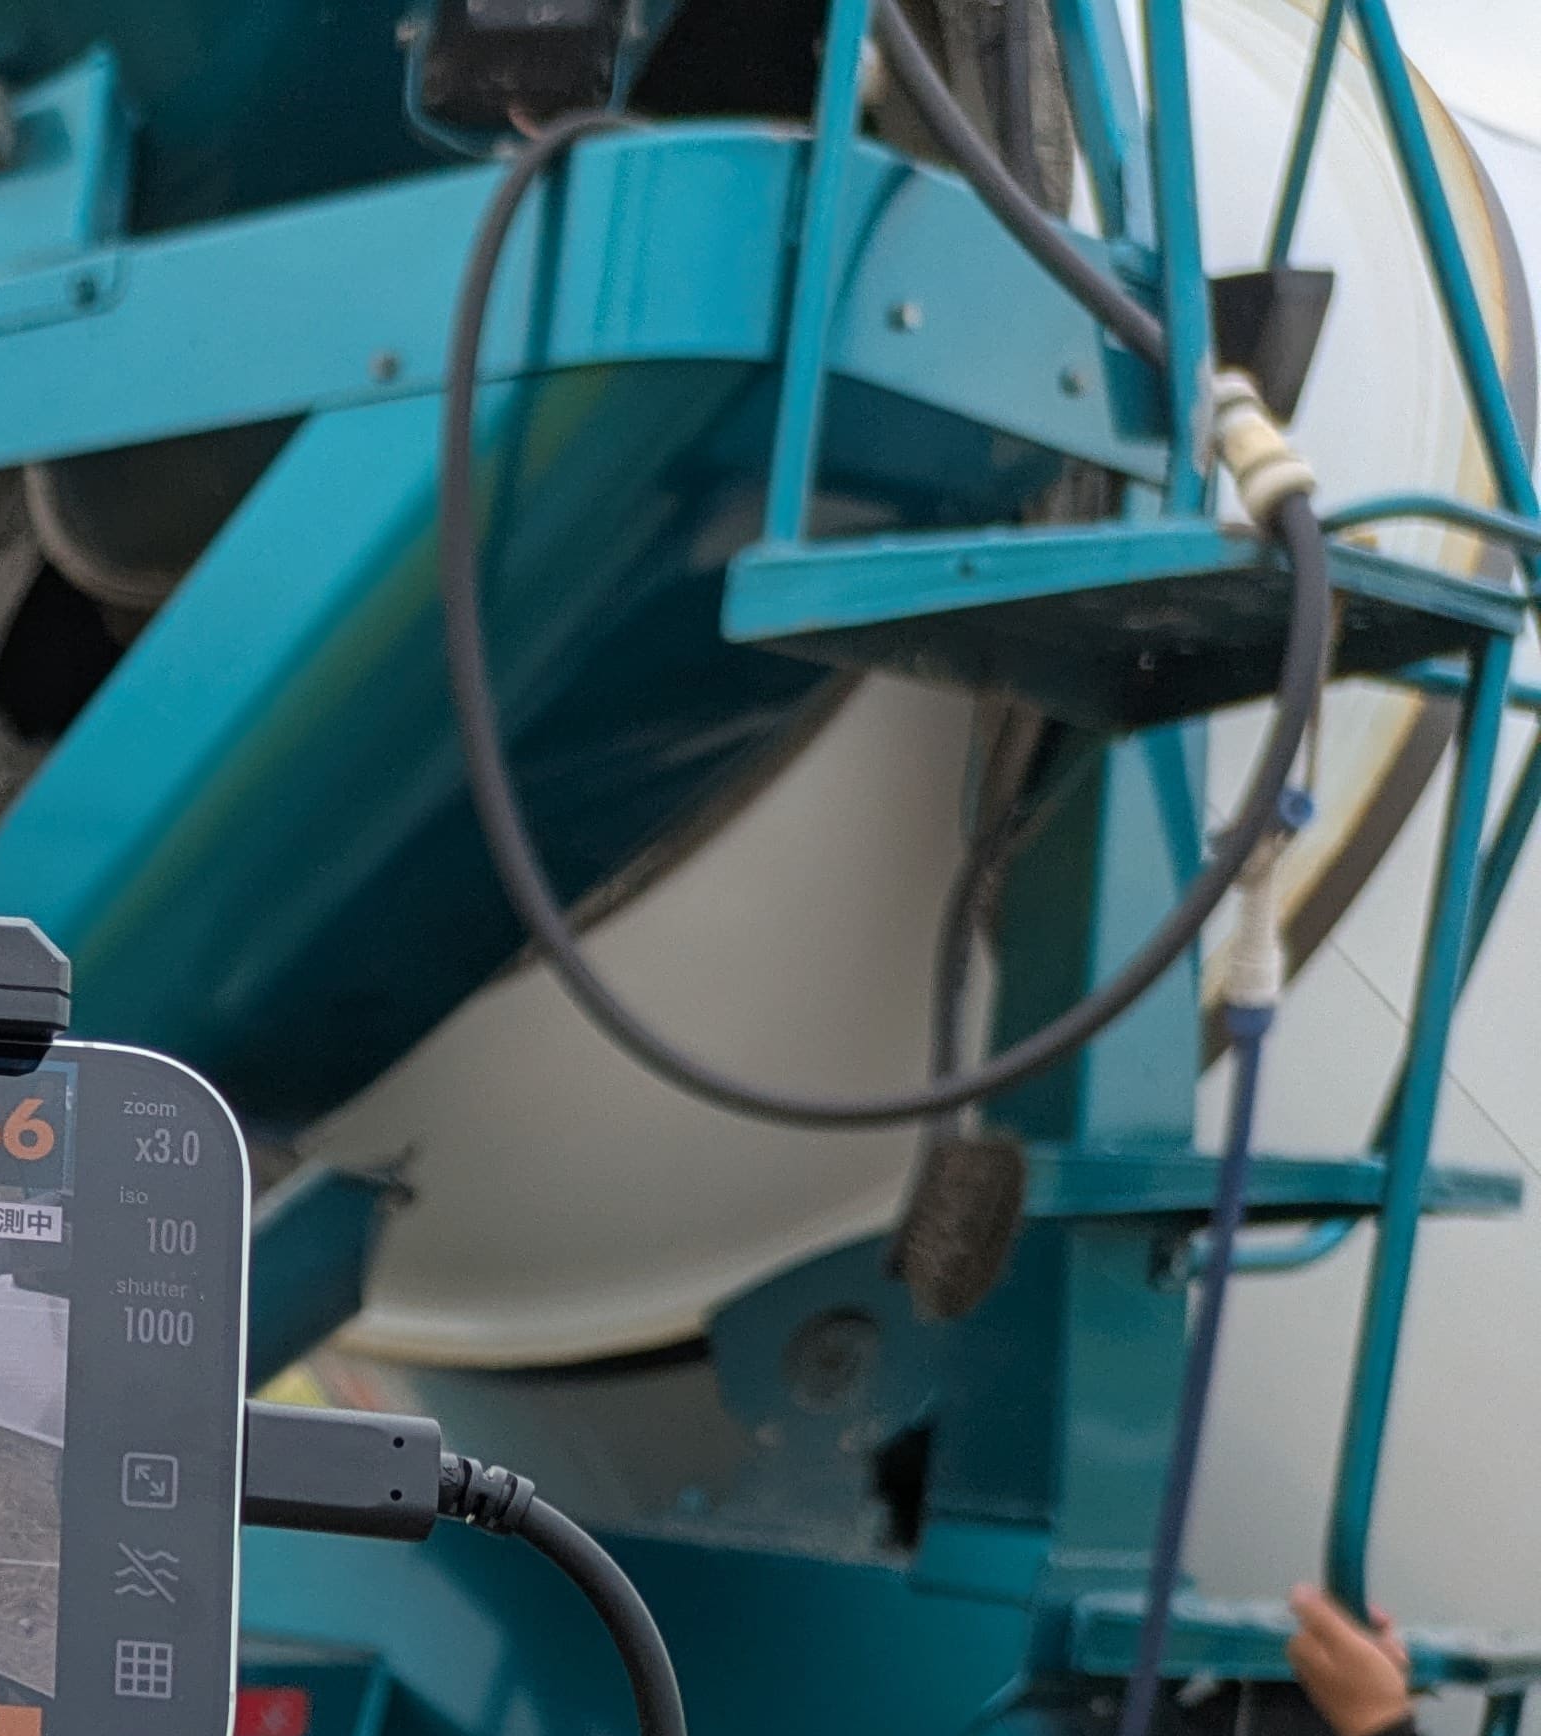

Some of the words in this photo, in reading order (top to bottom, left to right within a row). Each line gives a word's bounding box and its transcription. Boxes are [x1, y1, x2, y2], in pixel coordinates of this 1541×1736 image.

[123, 1101, 178, 1117] zoom
[135, 1128, 200, 1167] x3.0
[120, 1186, 149, 1205] iso
[147, 1217, 197, 1256] 100
[117, 1278, 189, 1299] shutter
[124, 1307, 193, 1346] 1000
